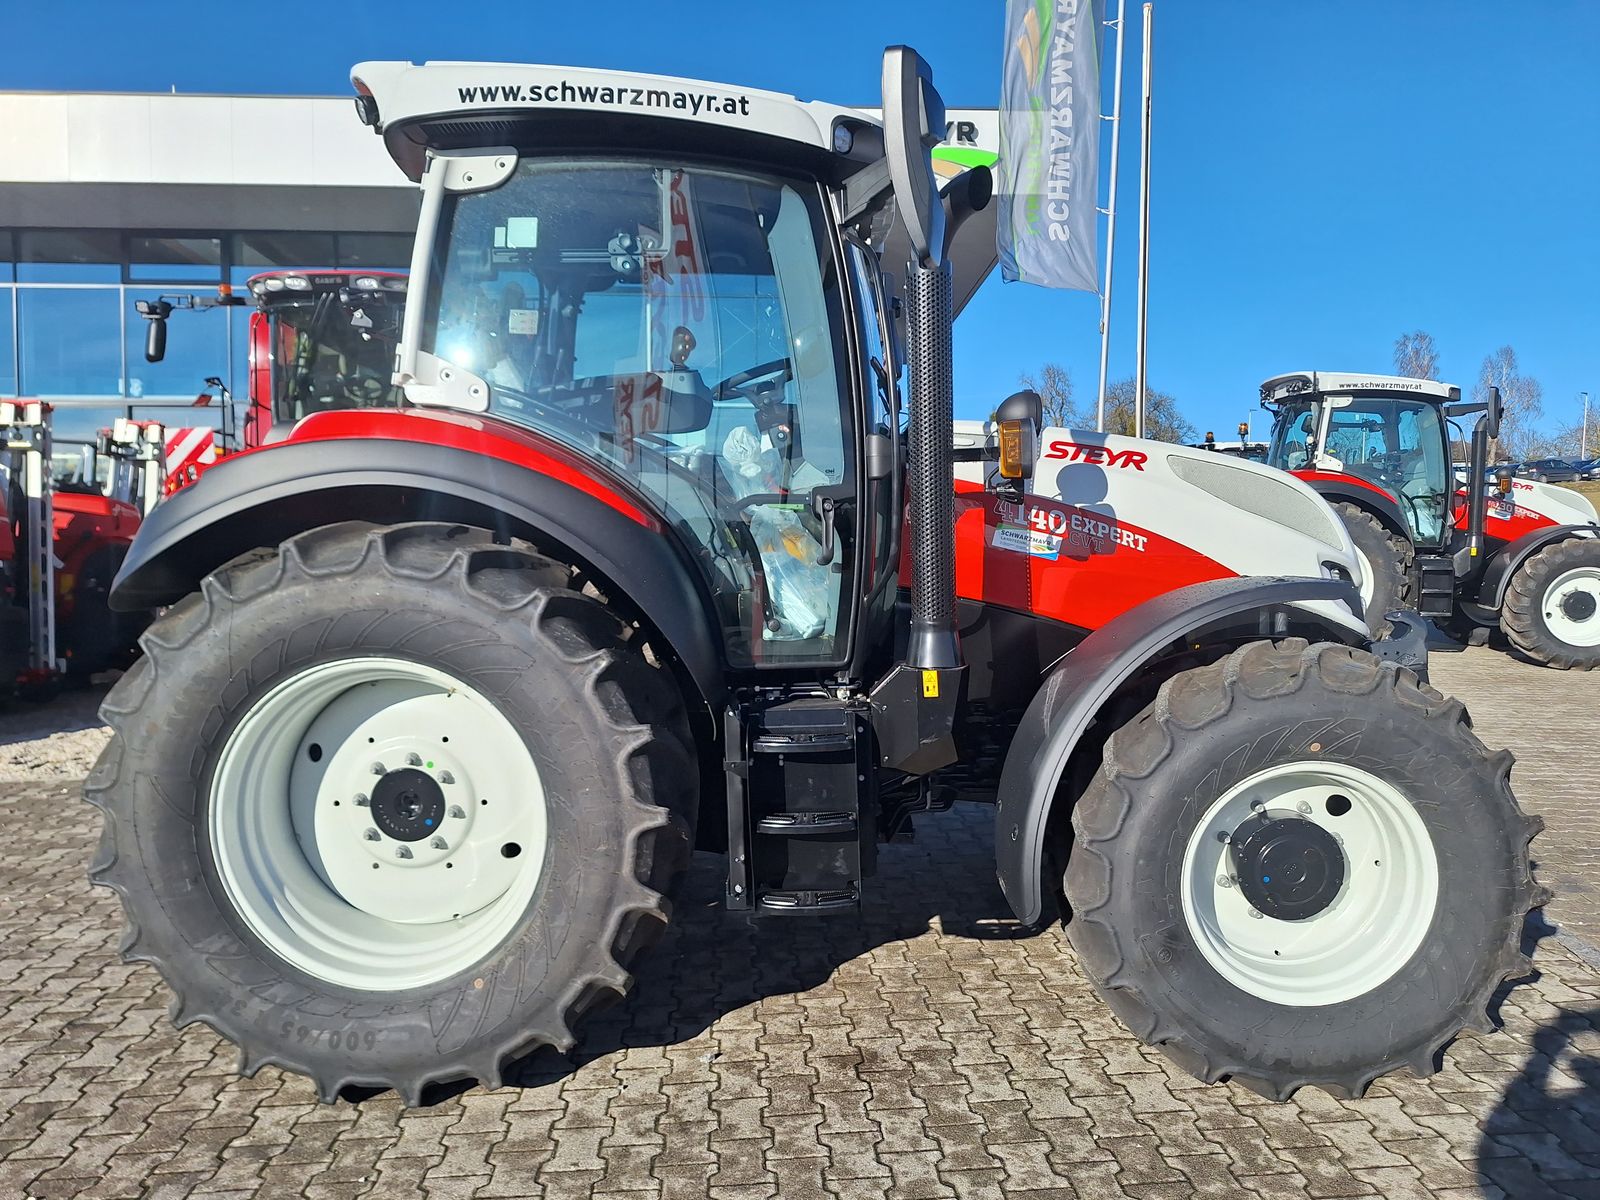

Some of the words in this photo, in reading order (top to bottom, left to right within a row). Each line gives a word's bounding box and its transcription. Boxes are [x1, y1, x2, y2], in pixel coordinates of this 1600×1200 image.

[457, 80, 750, 116] www.schwarzmayr.at
[1338, 381, 1423, 391] www.schwarzmayr.at
[1043, 440, 1148, 472] STEYR
[1512, 481, 1534, 492] EYR
[1000, 529, 1052, 547] SCHWARZMAYR
[1069, 530, 1104, 553] CVT
[1071, 513, 1148, 552] EXPERT
[279, 1020, 377, 1052] 600/65
